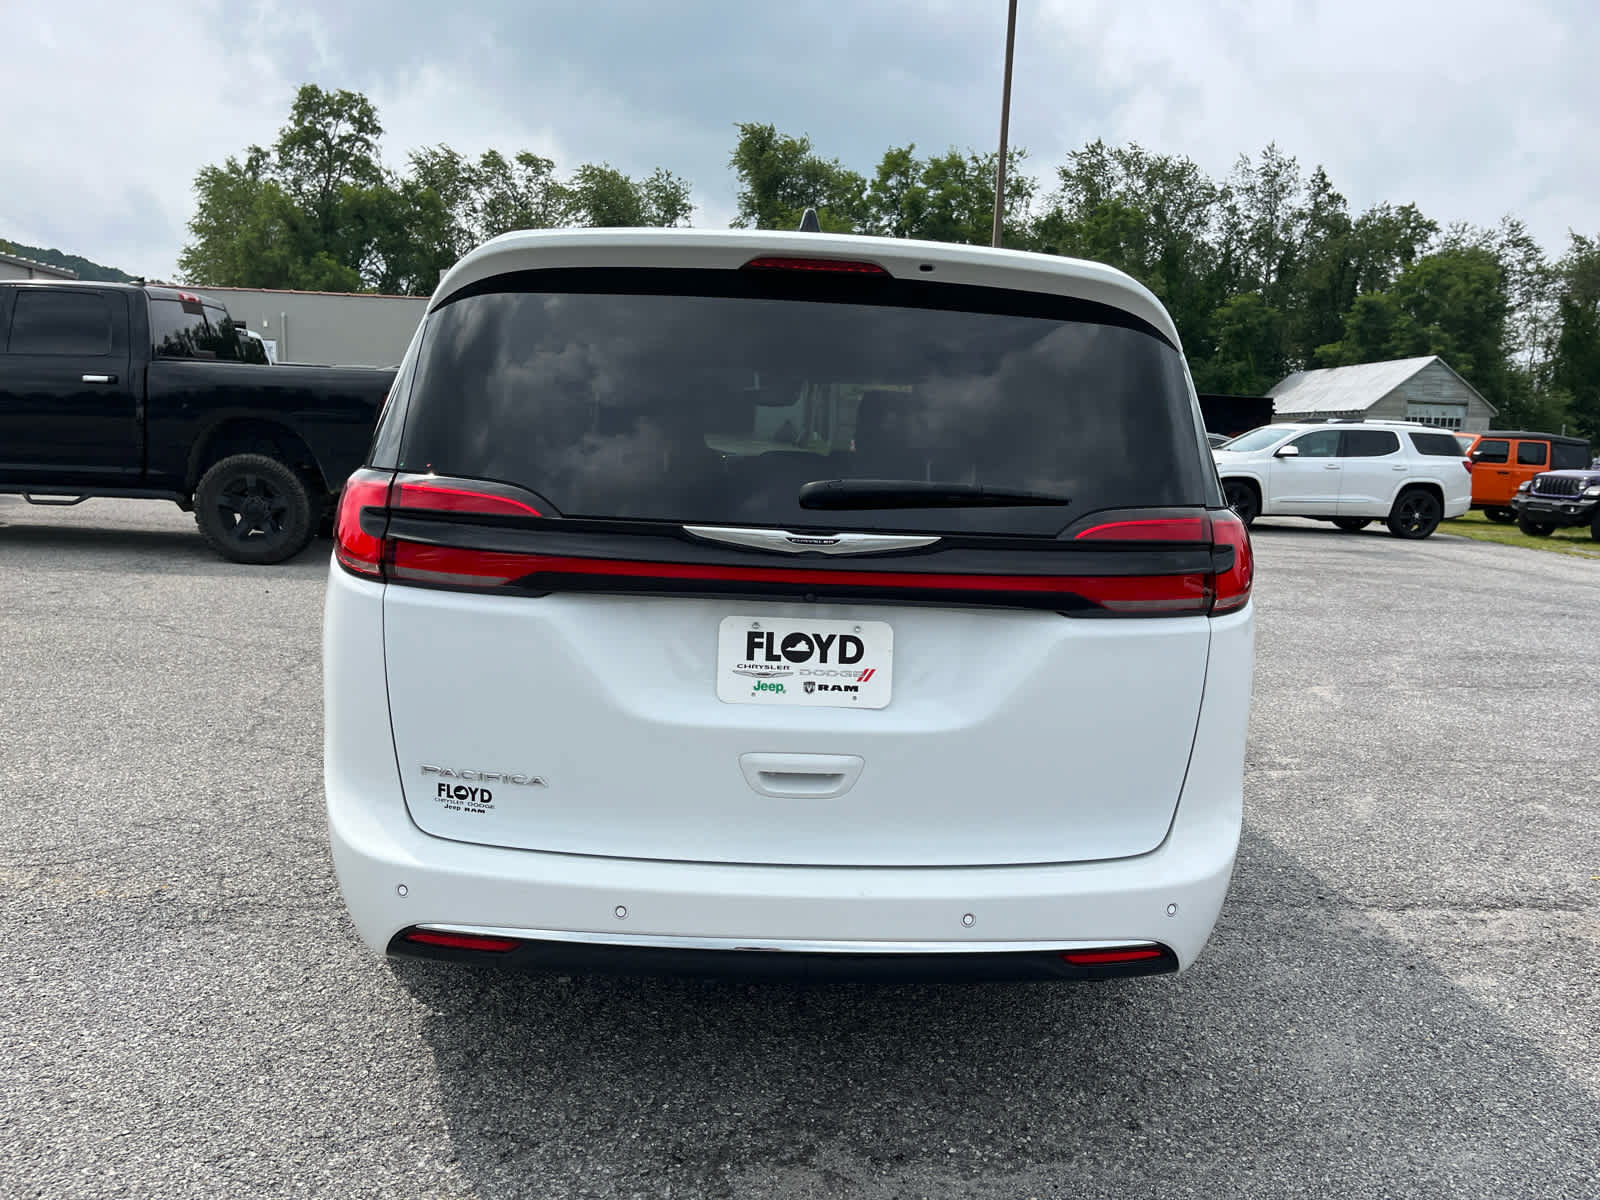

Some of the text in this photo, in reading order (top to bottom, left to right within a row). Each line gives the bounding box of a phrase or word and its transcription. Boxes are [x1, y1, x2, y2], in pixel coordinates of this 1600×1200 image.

[746, 630, 865, 664] FLOYD
[736, 663, 864, 678] CHRYSLER DODGE
[753, 680, 859, 694] Jeep RAM
[421, 764, 550, 788] PACIFICA
[437, 783, 492, 803] FLOYD
